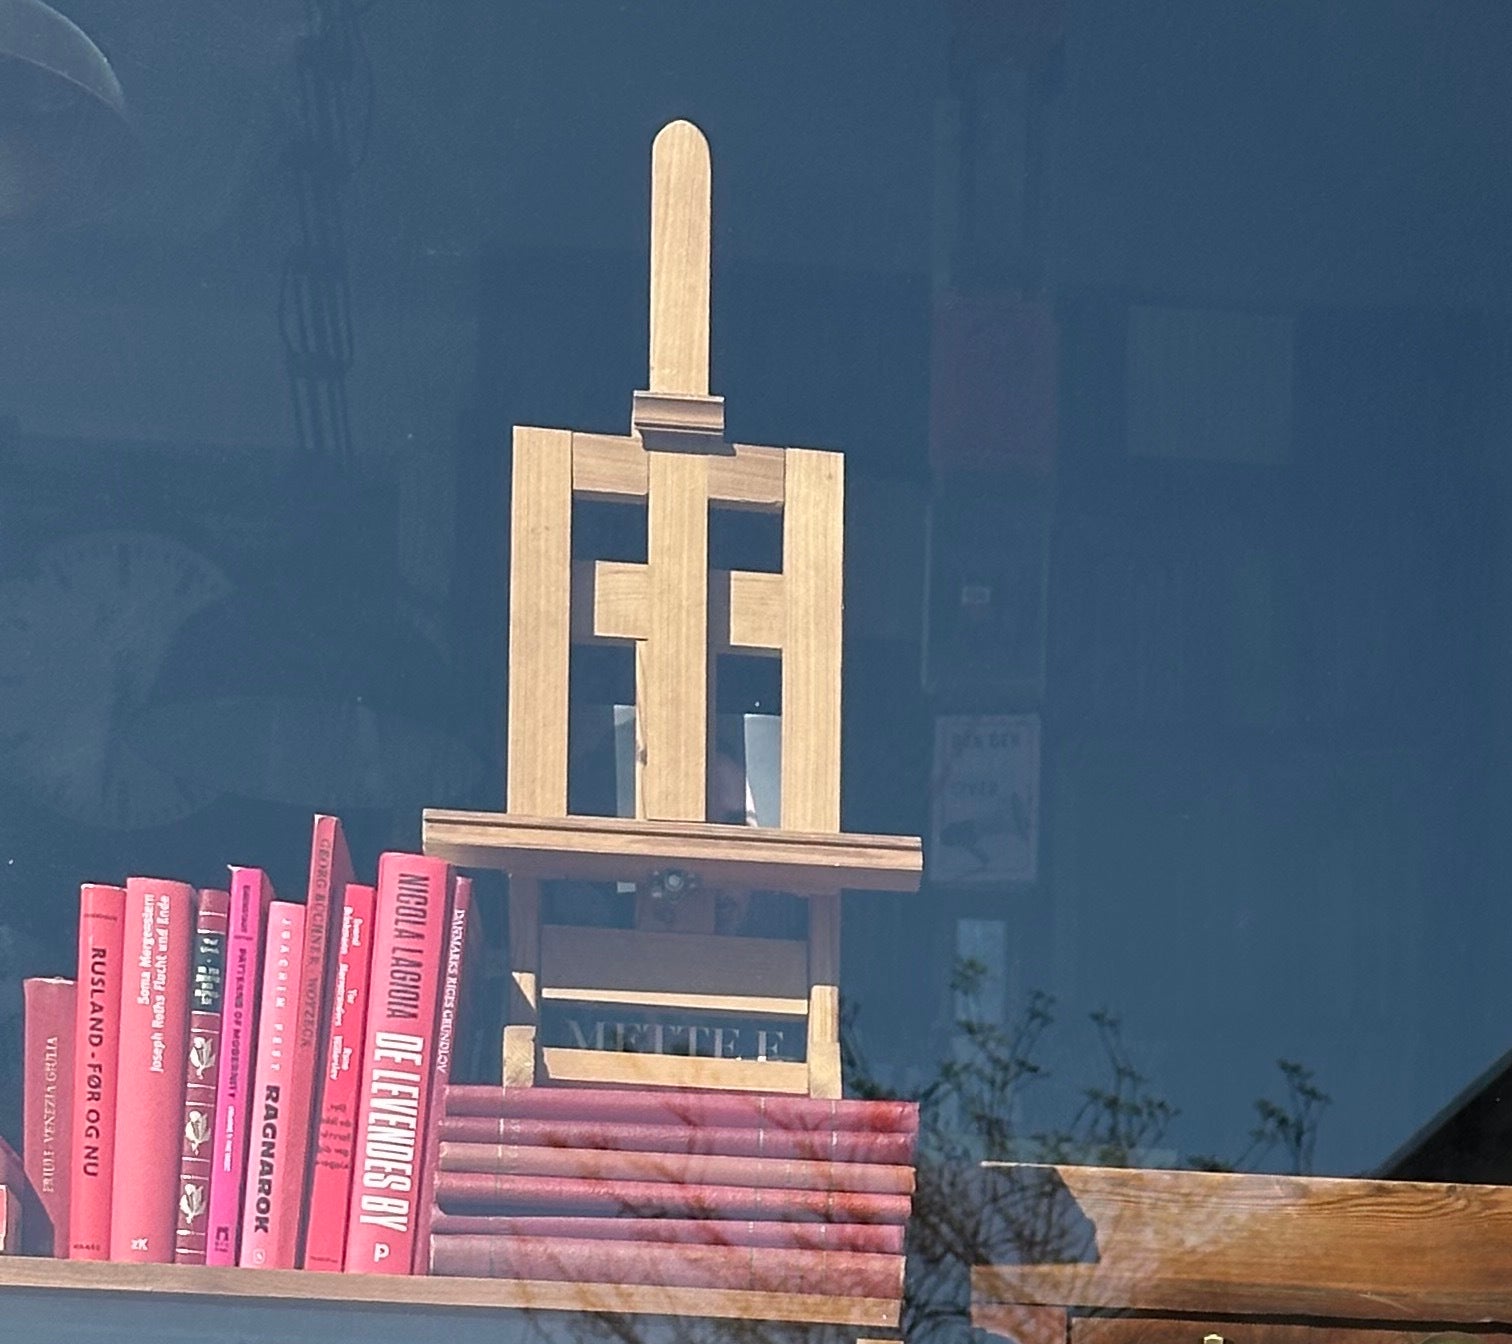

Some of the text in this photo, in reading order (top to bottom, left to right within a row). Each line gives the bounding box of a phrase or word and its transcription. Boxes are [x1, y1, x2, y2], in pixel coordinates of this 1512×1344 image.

[316, 837, 331, 888] GEORG
[88, 947, 107, 1047] RUSLAND
[137, 893, 155, 1005] Soma Morgenstern
[150, 894, 170, 1073] Joseph Roths Flucht und Ende
[271, 918, 291, 1071] JOACHIM FEST
[385, 873, 429, 1020] NICOLA LAGIOIA
[436, 908, 465, 1073] DANMARKS RIGES GRUNDLOV
[86, 1063, 103, 1102] FØR
[228, 948, 248, 1100] PATTERNS OF MODERNITY
[42, 1086, 57, 1143] VENEZIA
[82, 1145, 100, 1177] NU
[85, 1109, 101, 1138] OG
[254, 1084, 280, 1234] RAGNAROK
[360, 1032, 424, 1232] DE LEVENDES BY
